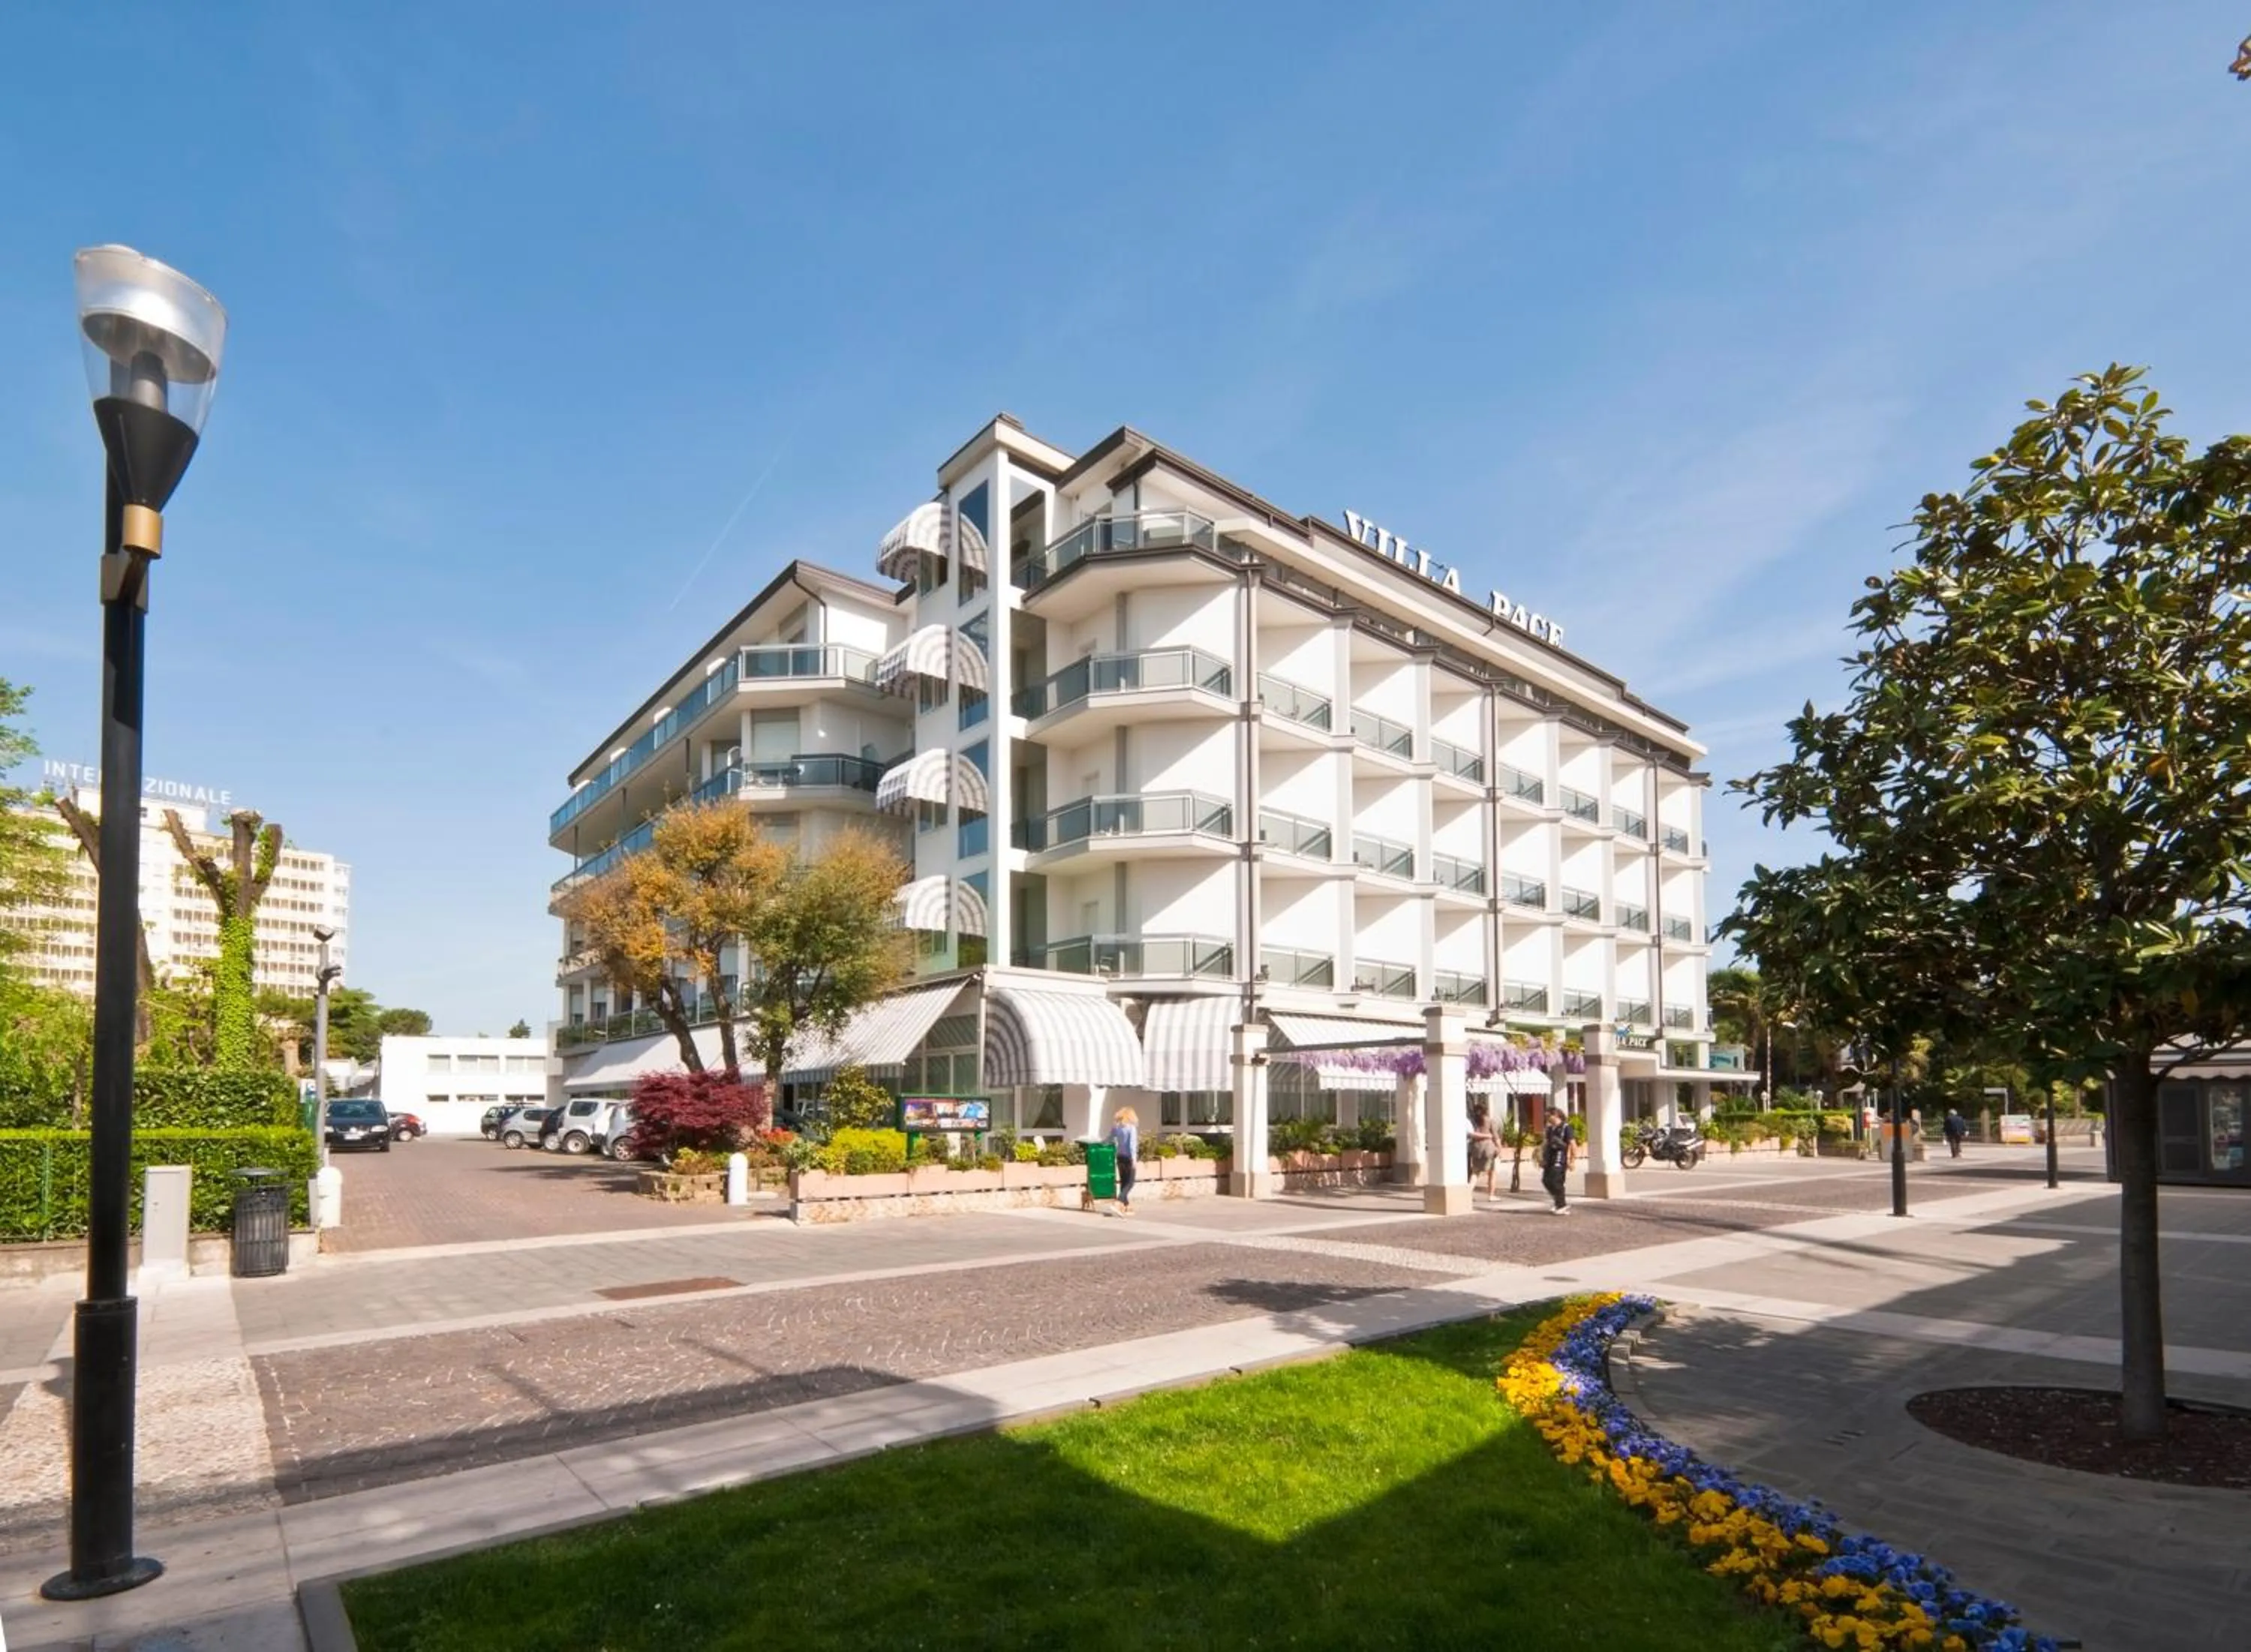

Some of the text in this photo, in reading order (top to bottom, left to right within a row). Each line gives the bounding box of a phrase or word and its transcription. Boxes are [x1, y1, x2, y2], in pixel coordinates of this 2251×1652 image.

[1344, 509, 1564, 649] VILLA PACE
[44, 758, 233, 806] INTEZIONALE
